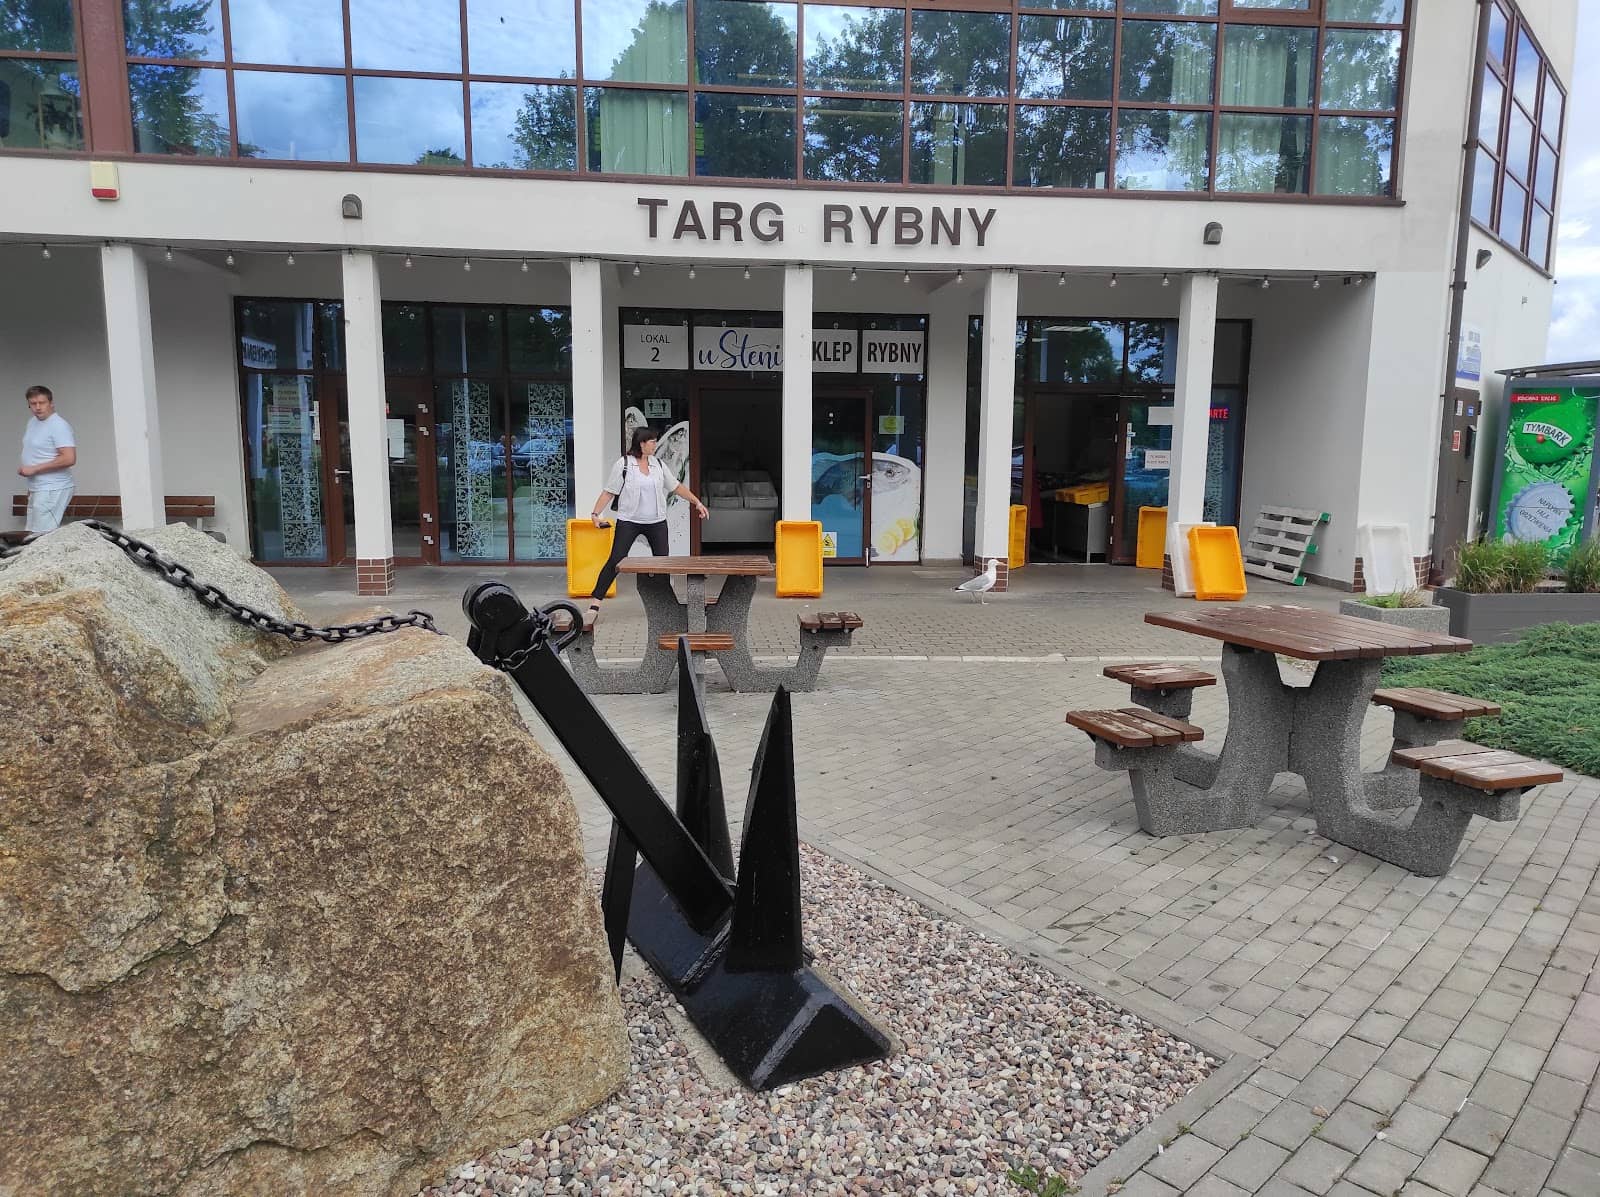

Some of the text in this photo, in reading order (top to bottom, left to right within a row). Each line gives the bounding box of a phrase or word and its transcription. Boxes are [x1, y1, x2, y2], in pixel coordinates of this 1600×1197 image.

[637, 197, 998, 247] TARG RYBNY
[640, 334, 671, 344] LOKAL
[651, 346, 660, 362] 2
[812, 341, 922, 363] KLEP RYBNY
[1525, 423, 1569, 446] TYMBARK
